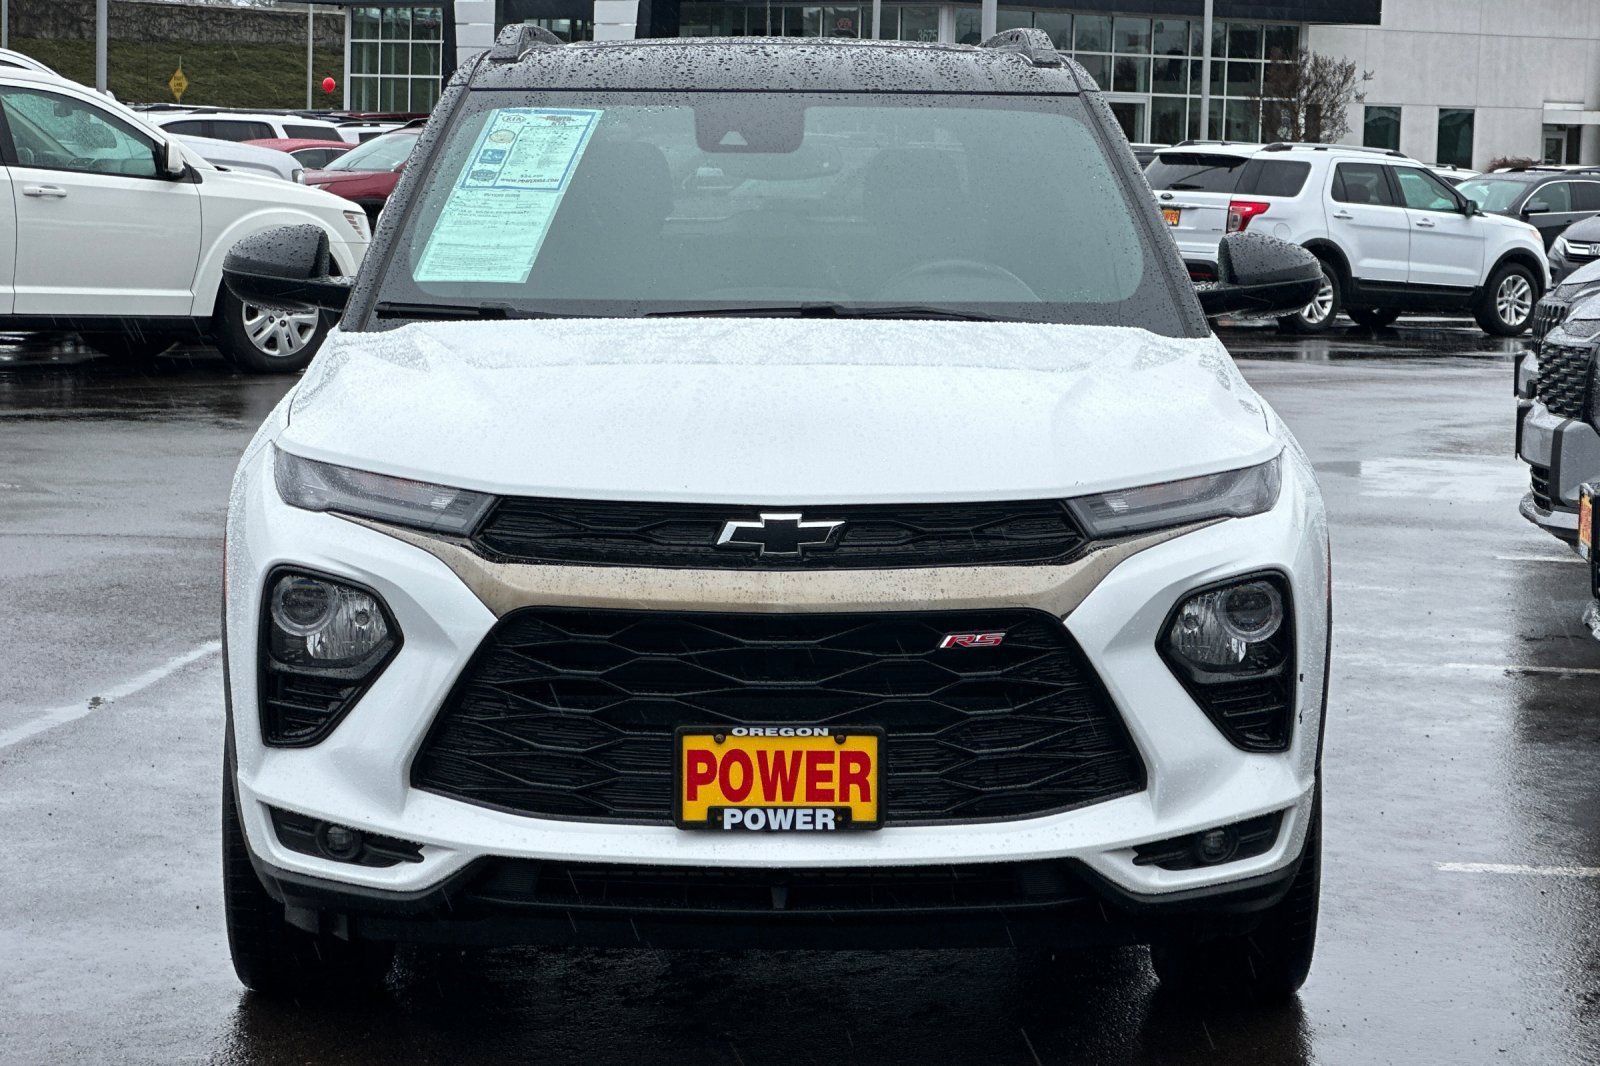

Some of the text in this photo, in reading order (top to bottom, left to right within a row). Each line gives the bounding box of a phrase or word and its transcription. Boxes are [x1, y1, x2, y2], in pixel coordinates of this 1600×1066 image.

[917, 29, 938, 42] 3675
[940, 632, 1006, 648] RS
[731, 727, 829, 737] OREGON
[686, 748, 872, 803] POWER
[723, 808, 836, 830] POWER
